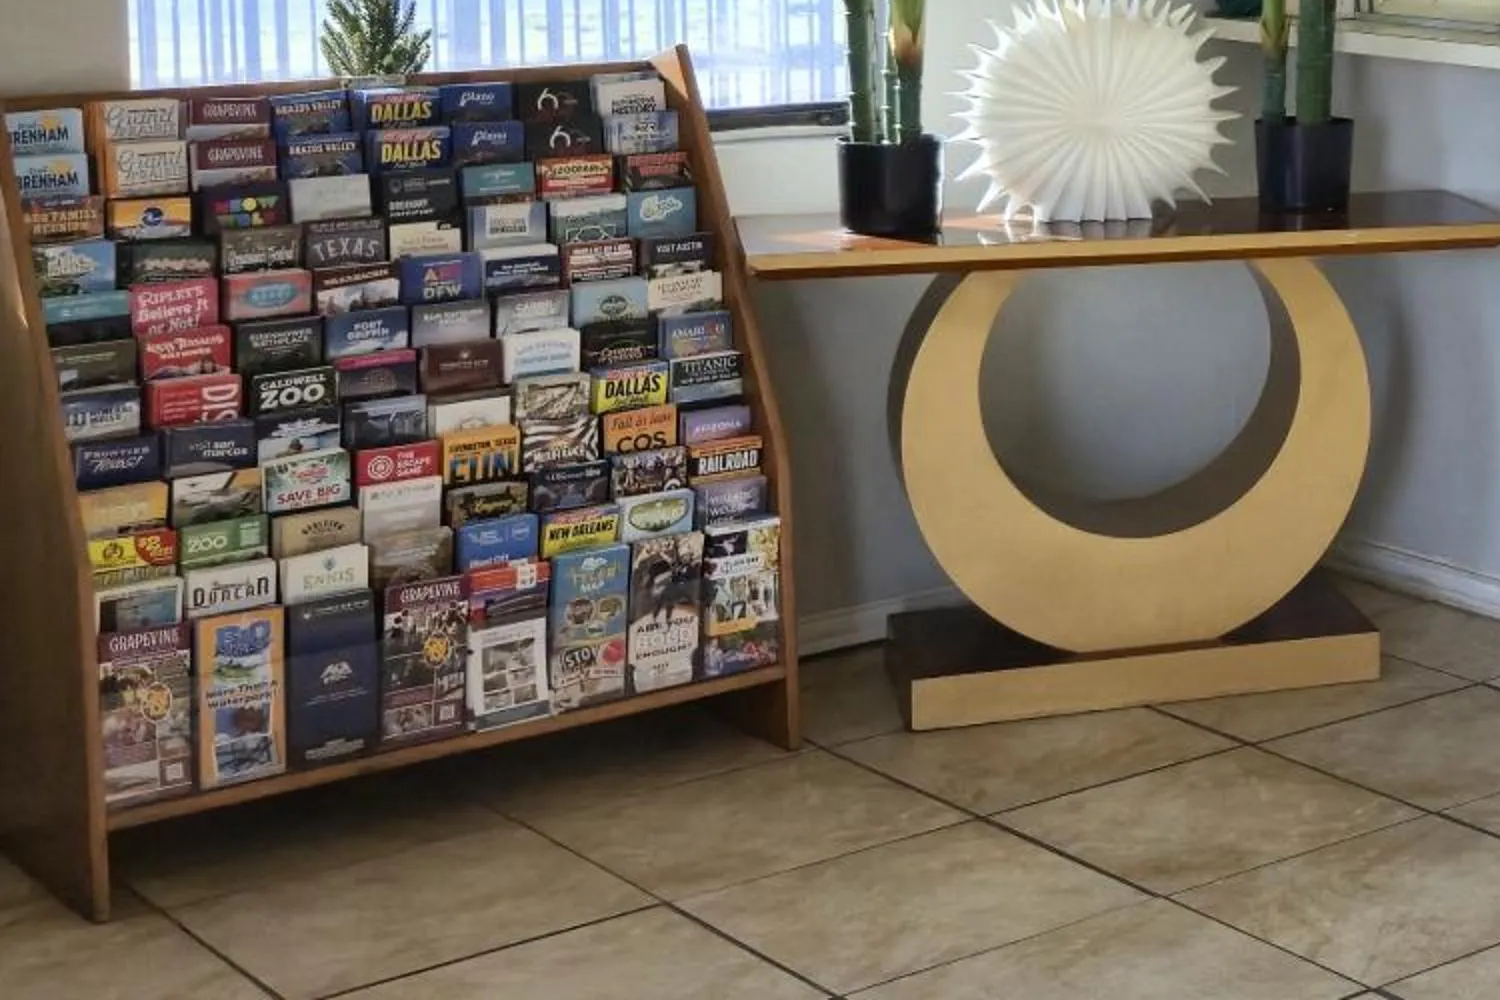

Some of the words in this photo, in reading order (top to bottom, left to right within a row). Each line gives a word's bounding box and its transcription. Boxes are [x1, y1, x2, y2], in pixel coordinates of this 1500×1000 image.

[203, 102, 258, 118] GRAPEVINE
[371, 101, 433, 123] DALLAS
[12, 126, 69, 146] RENHAM
[207, 146, 265, 162] GRAPEVINE
[381, 139, 442, 163] DALLAS
[312, 237, 381, 262] TEXAS
[680, 355, 738, 374] TITANIC
[259, 373, 327, 392] CALDWELL
[605, 374, 662, 400] DALLAS
[259, 383, 326, 411] ZOO
[615, 430, 668, 455] COS
[698, 449, 759, 475] RAILROAD
[276, 487, 311, 505] SAVE
[317, 482, 342, 498] BIG
[548, 525, 570, 540] NEW
[571, 518, 615, 538] ORLEANS
[187, 533, 228, 554] ZOO
[401, 581, 462, 602] GRAPEVINE
[636, 621, 663, 634] ARE
[109, 628, 180, 653] GRAPEVINE
